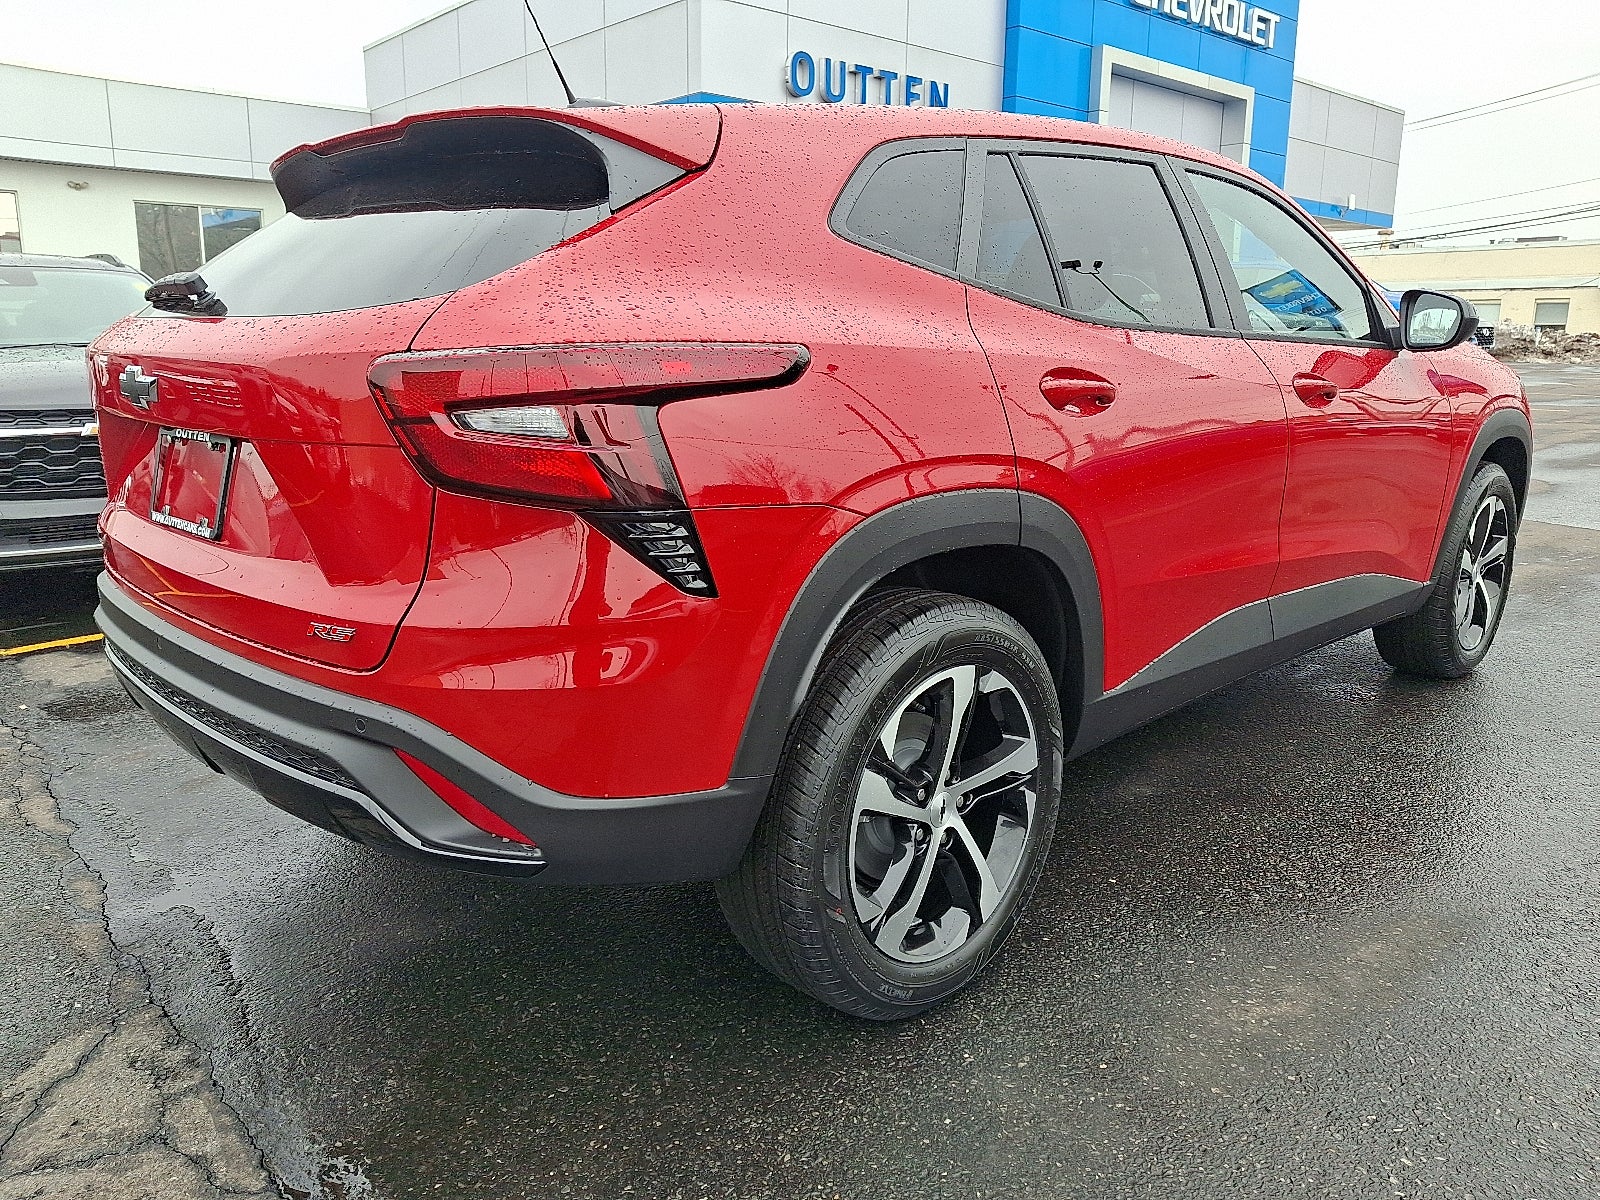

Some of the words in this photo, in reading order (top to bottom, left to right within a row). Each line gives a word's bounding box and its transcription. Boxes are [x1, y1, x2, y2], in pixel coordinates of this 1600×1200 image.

[787, 51, 949, 107] OUTTEN
[175, 429, 210, 442] OUTTEN
[307, 622, 357, 642] RS
